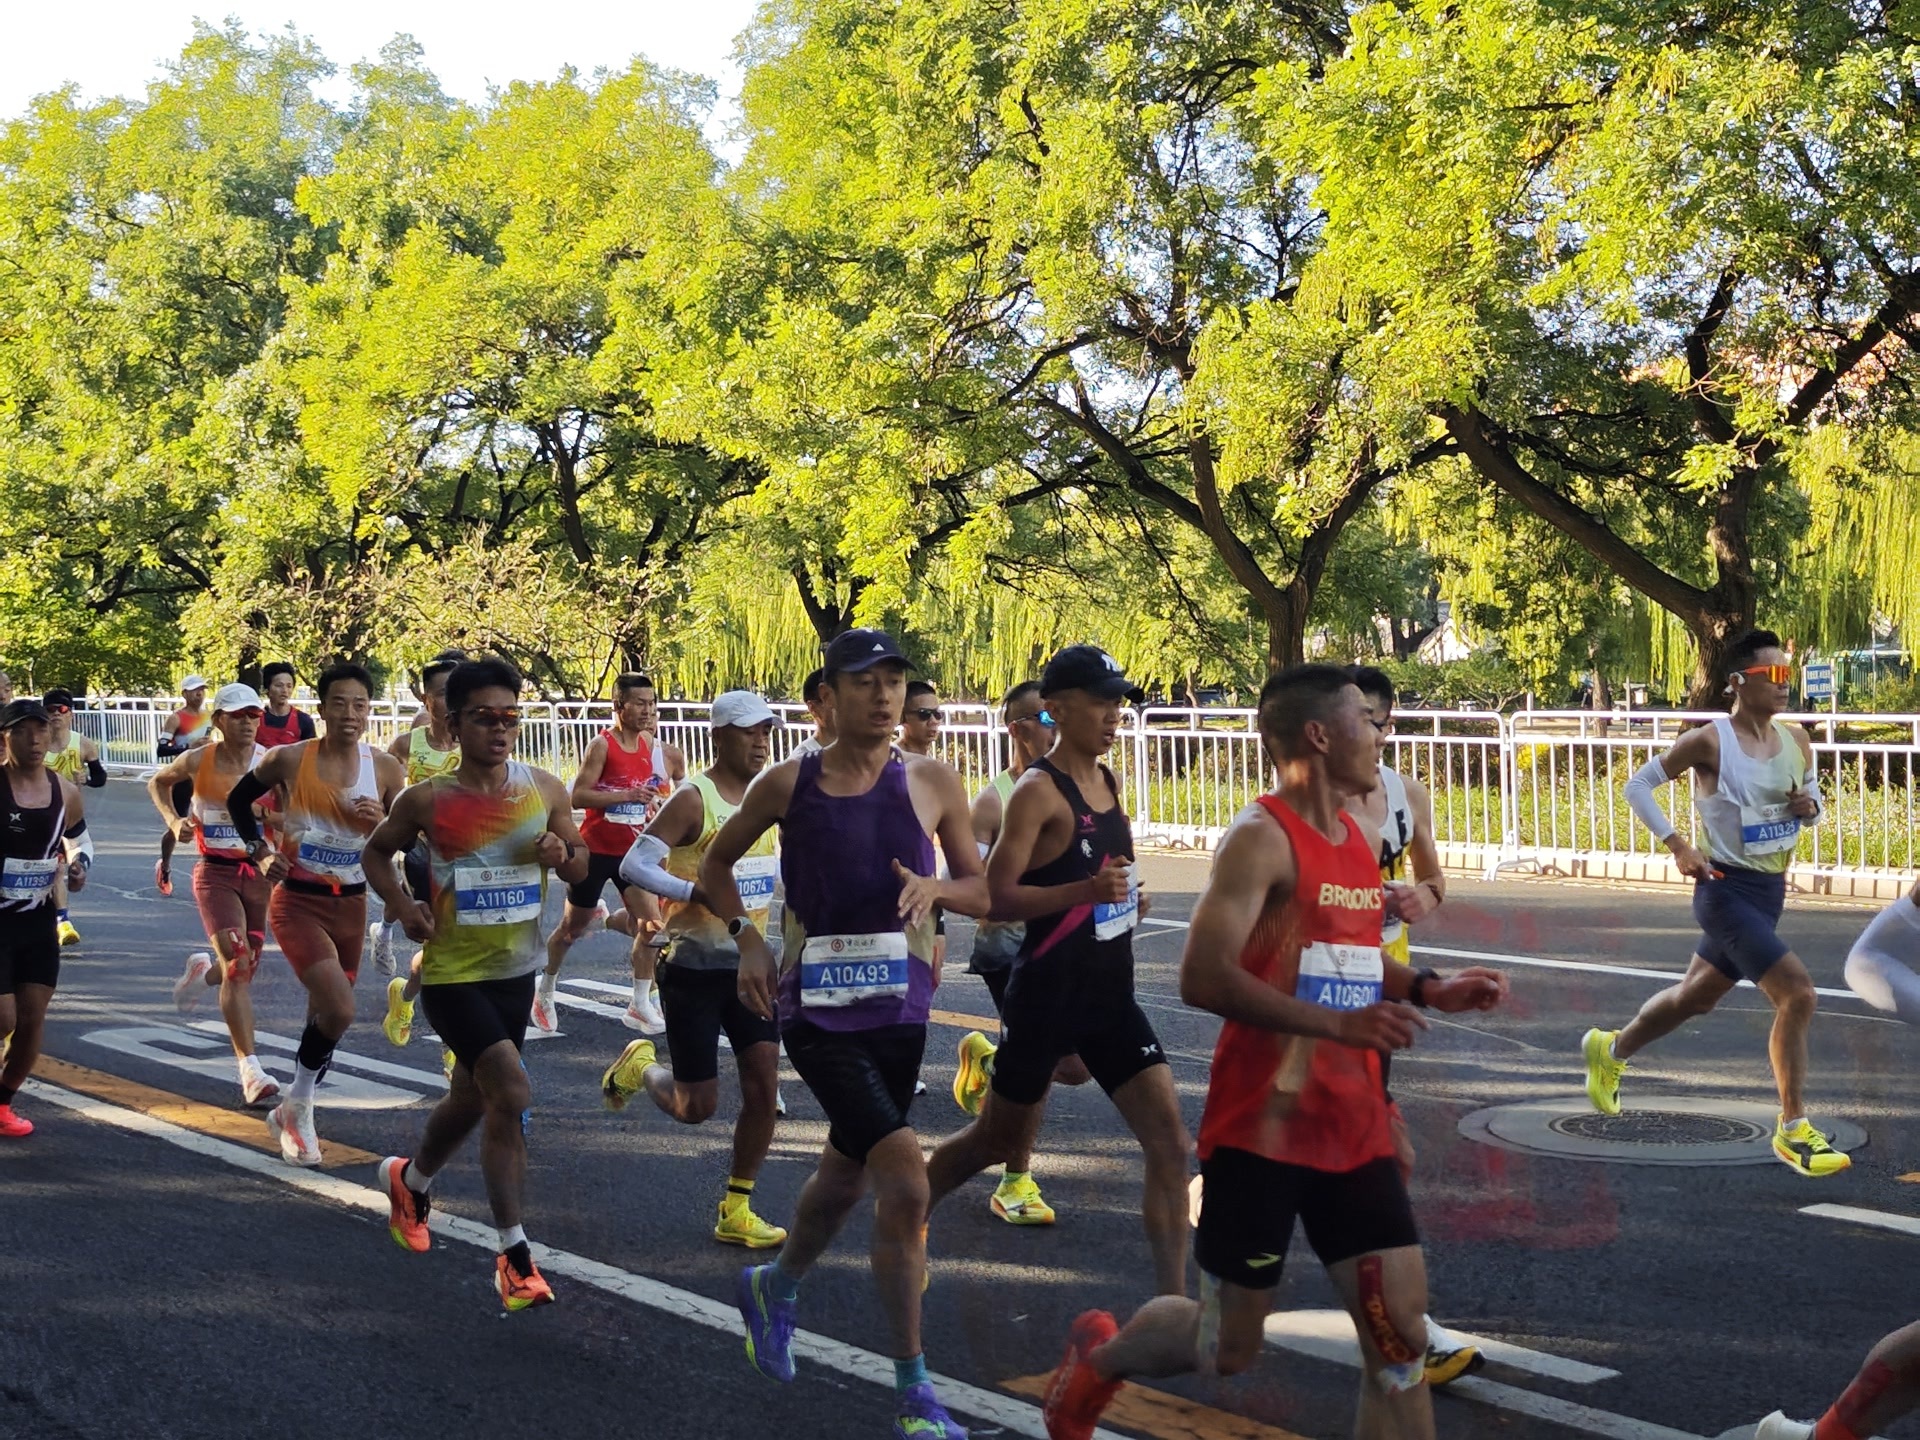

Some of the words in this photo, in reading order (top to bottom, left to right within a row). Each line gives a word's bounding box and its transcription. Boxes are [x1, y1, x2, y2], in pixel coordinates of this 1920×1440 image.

[738, 879, 767, 896] 10674
[1319, 883, 1381, 910] BROOKS
[475, 889, 525, 907] A11160
[820, 964, 889, 985] A10493
